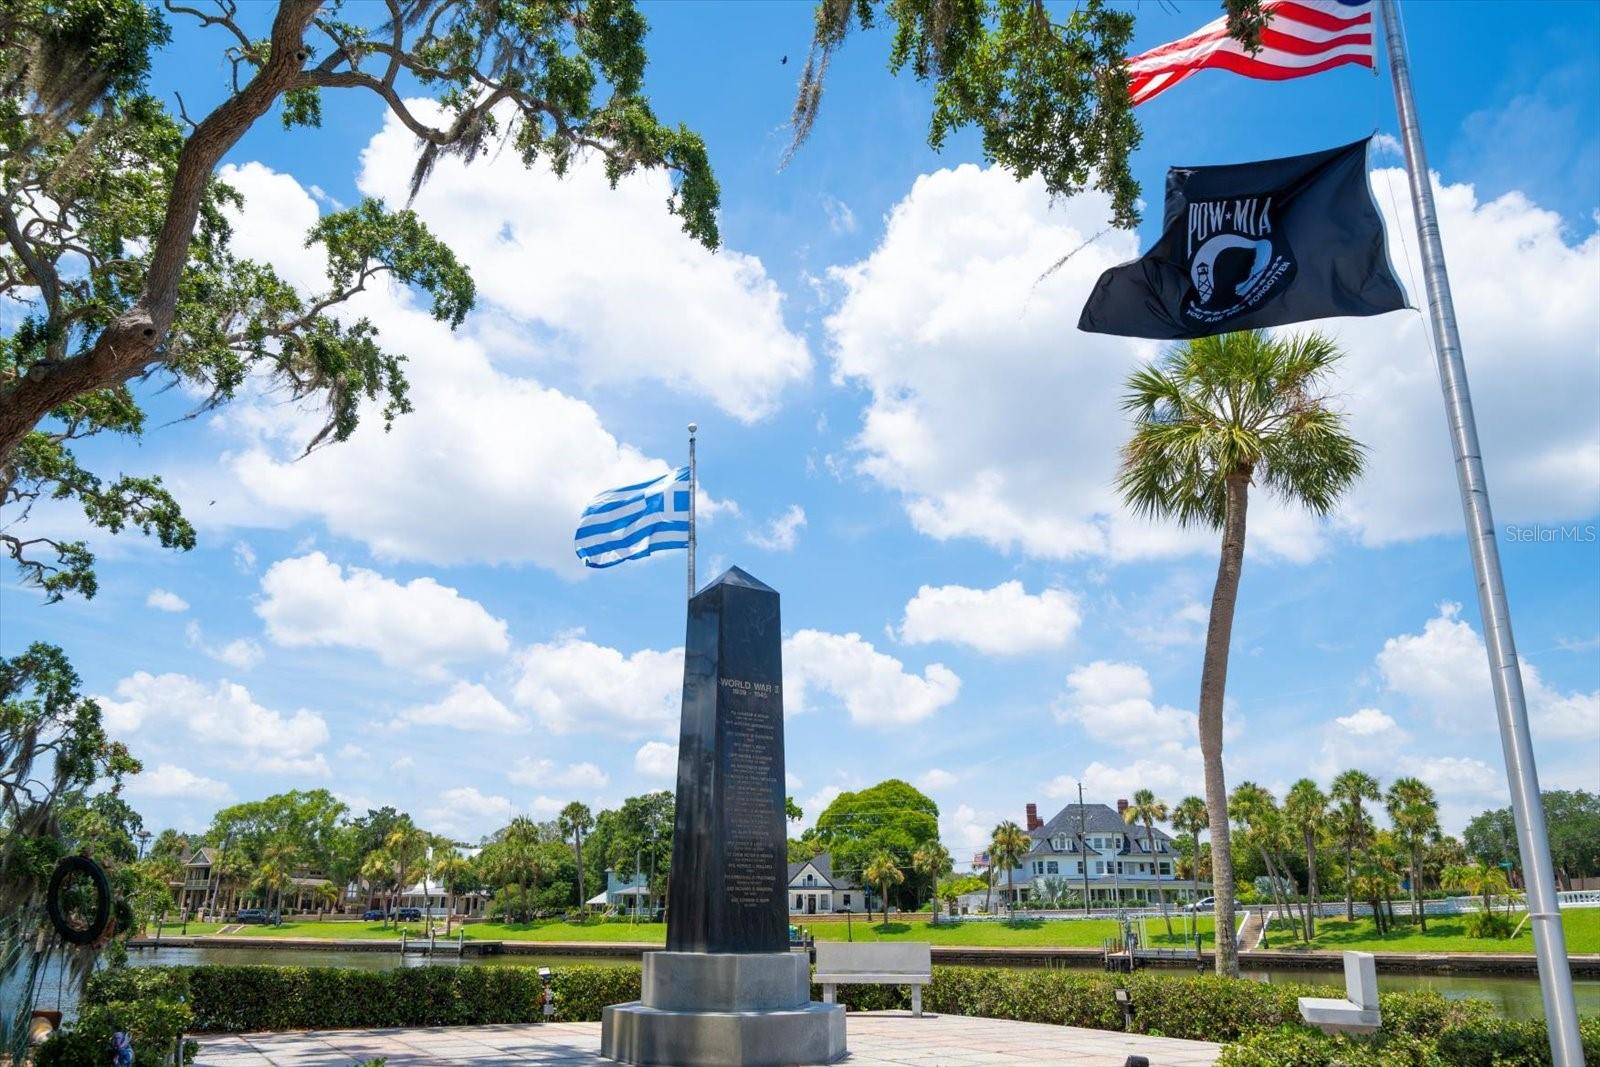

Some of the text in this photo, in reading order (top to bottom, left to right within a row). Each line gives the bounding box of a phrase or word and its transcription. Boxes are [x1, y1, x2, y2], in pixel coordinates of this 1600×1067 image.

[1187, 196, 1272, 259] POW MIA
[1186, 309, 1203, 320] YOU
[720, 677, 751, 690] WORLD
[753, 682, 772, 693] WAR
